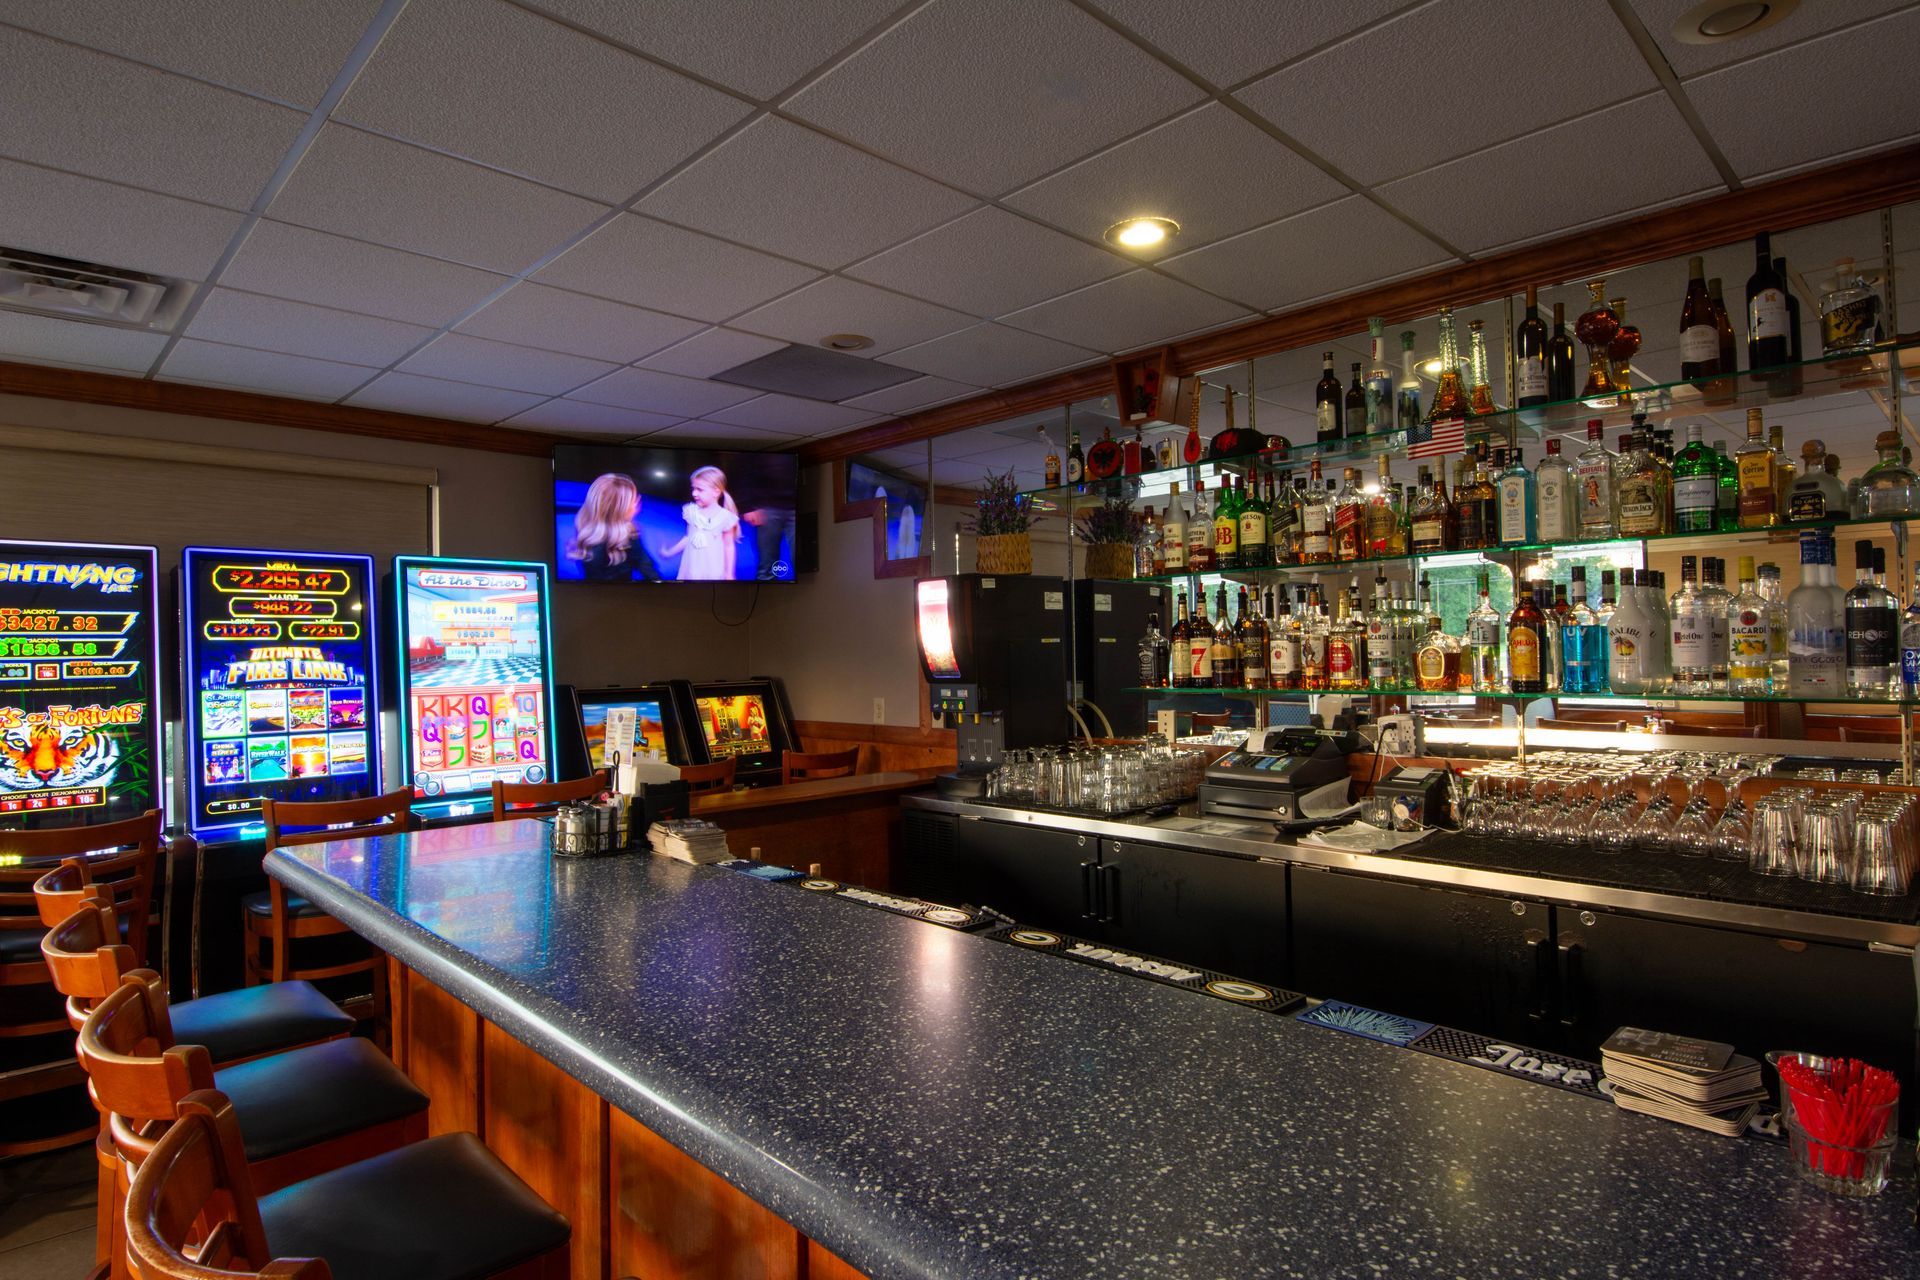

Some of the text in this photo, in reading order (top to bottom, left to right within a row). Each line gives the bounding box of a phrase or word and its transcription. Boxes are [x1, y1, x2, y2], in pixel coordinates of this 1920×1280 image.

[266, 561, 298, 571] MEGA
[772, 564, 787, 573] abc
[230, 570, 332, 590] $2,295.47
[424, 574, 521, 588] At the Diner
[252, 600, 313, 614] $946.22
[214, 625, 271, 637] $112.73
[301, 625, 345, 637] $72.91
[1609, 626, 1642, 639] MALIBU
[1731, 625, 1767, 634] BACARDÍ
[250, 646, 324, 661] ULTIMATE
[1191, 648, 1207, 676] 7
[225, 659, 349, 686] FIRE LINK
[421, 698, 439, 717] K
[446, 697, 463, 717] K
[471, 696, 490, 716] Q
[515, 695, 535, 713] 10
[48, 704, 143, 728] FORTUNE
[472, 719, 488, 740] J
[448, 745, 465, 766] J
[519, 740, 538, 760] Q
[51, 788, 99, 797] DENOMINATION
[228, 802, 250, 811] $0.00
[1468, 1044, 1592, 1085] Jose
